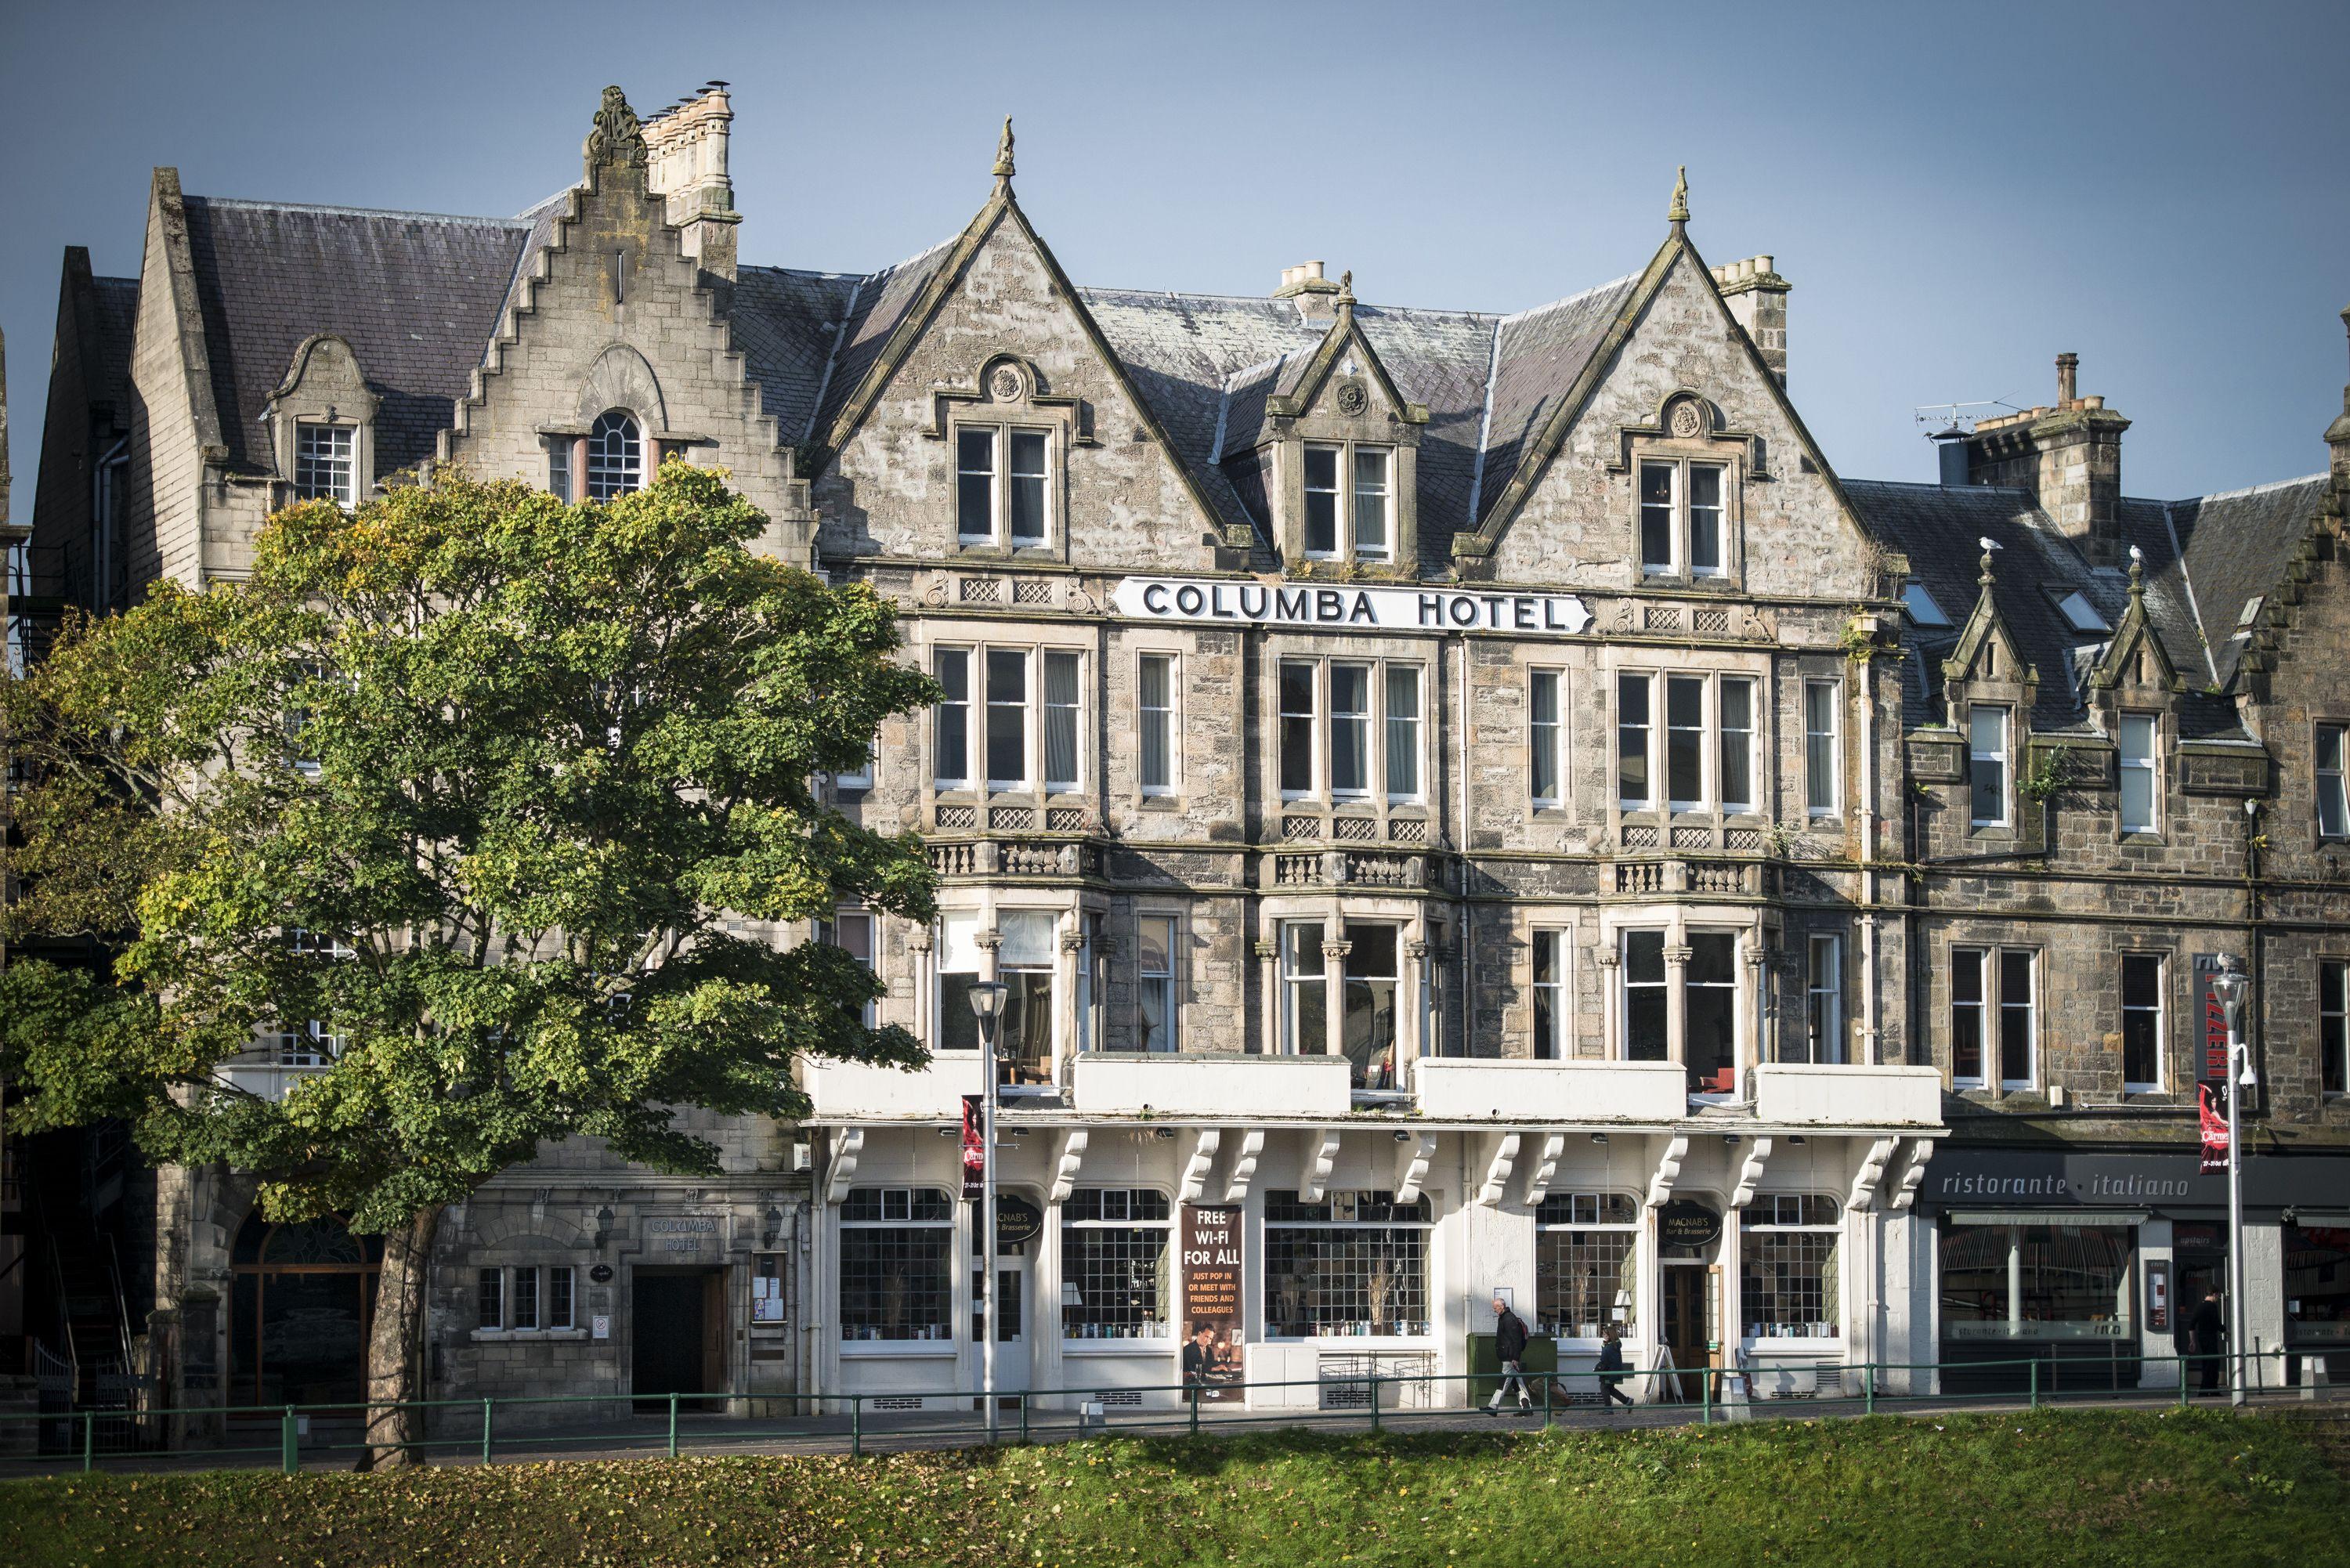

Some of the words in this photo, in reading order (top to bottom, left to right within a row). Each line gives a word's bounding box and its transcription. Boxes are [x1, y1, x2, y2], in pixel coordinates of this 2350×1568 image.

[1143, 583, 1376, 625] COLUMBA
[1418, 594, 1566, 630] HOTEL
[2202, 1130, 2229, 1142] Carme
[964, 1149, 983, 1162] Carm
[1943, 1172, 2066, 1194] ristorante
[2093, 1174, 2189, 1197] italiano
[996, 1213, 1028, 1222] CNAB'S
[1197, 1211, 1226, 1225] FREE
[1668, 1218, 1708, 1227] MACNAB'S
[652, 1220, 715, 1232] COLUMBA
[1195, 1230, 1228, 1245] WI-FI
[665, 1239, 700, 1251] HOTEL
[1184, 1251, 1210, 1265] FOR
[1216, 1249, 1239, 1265] ALL
